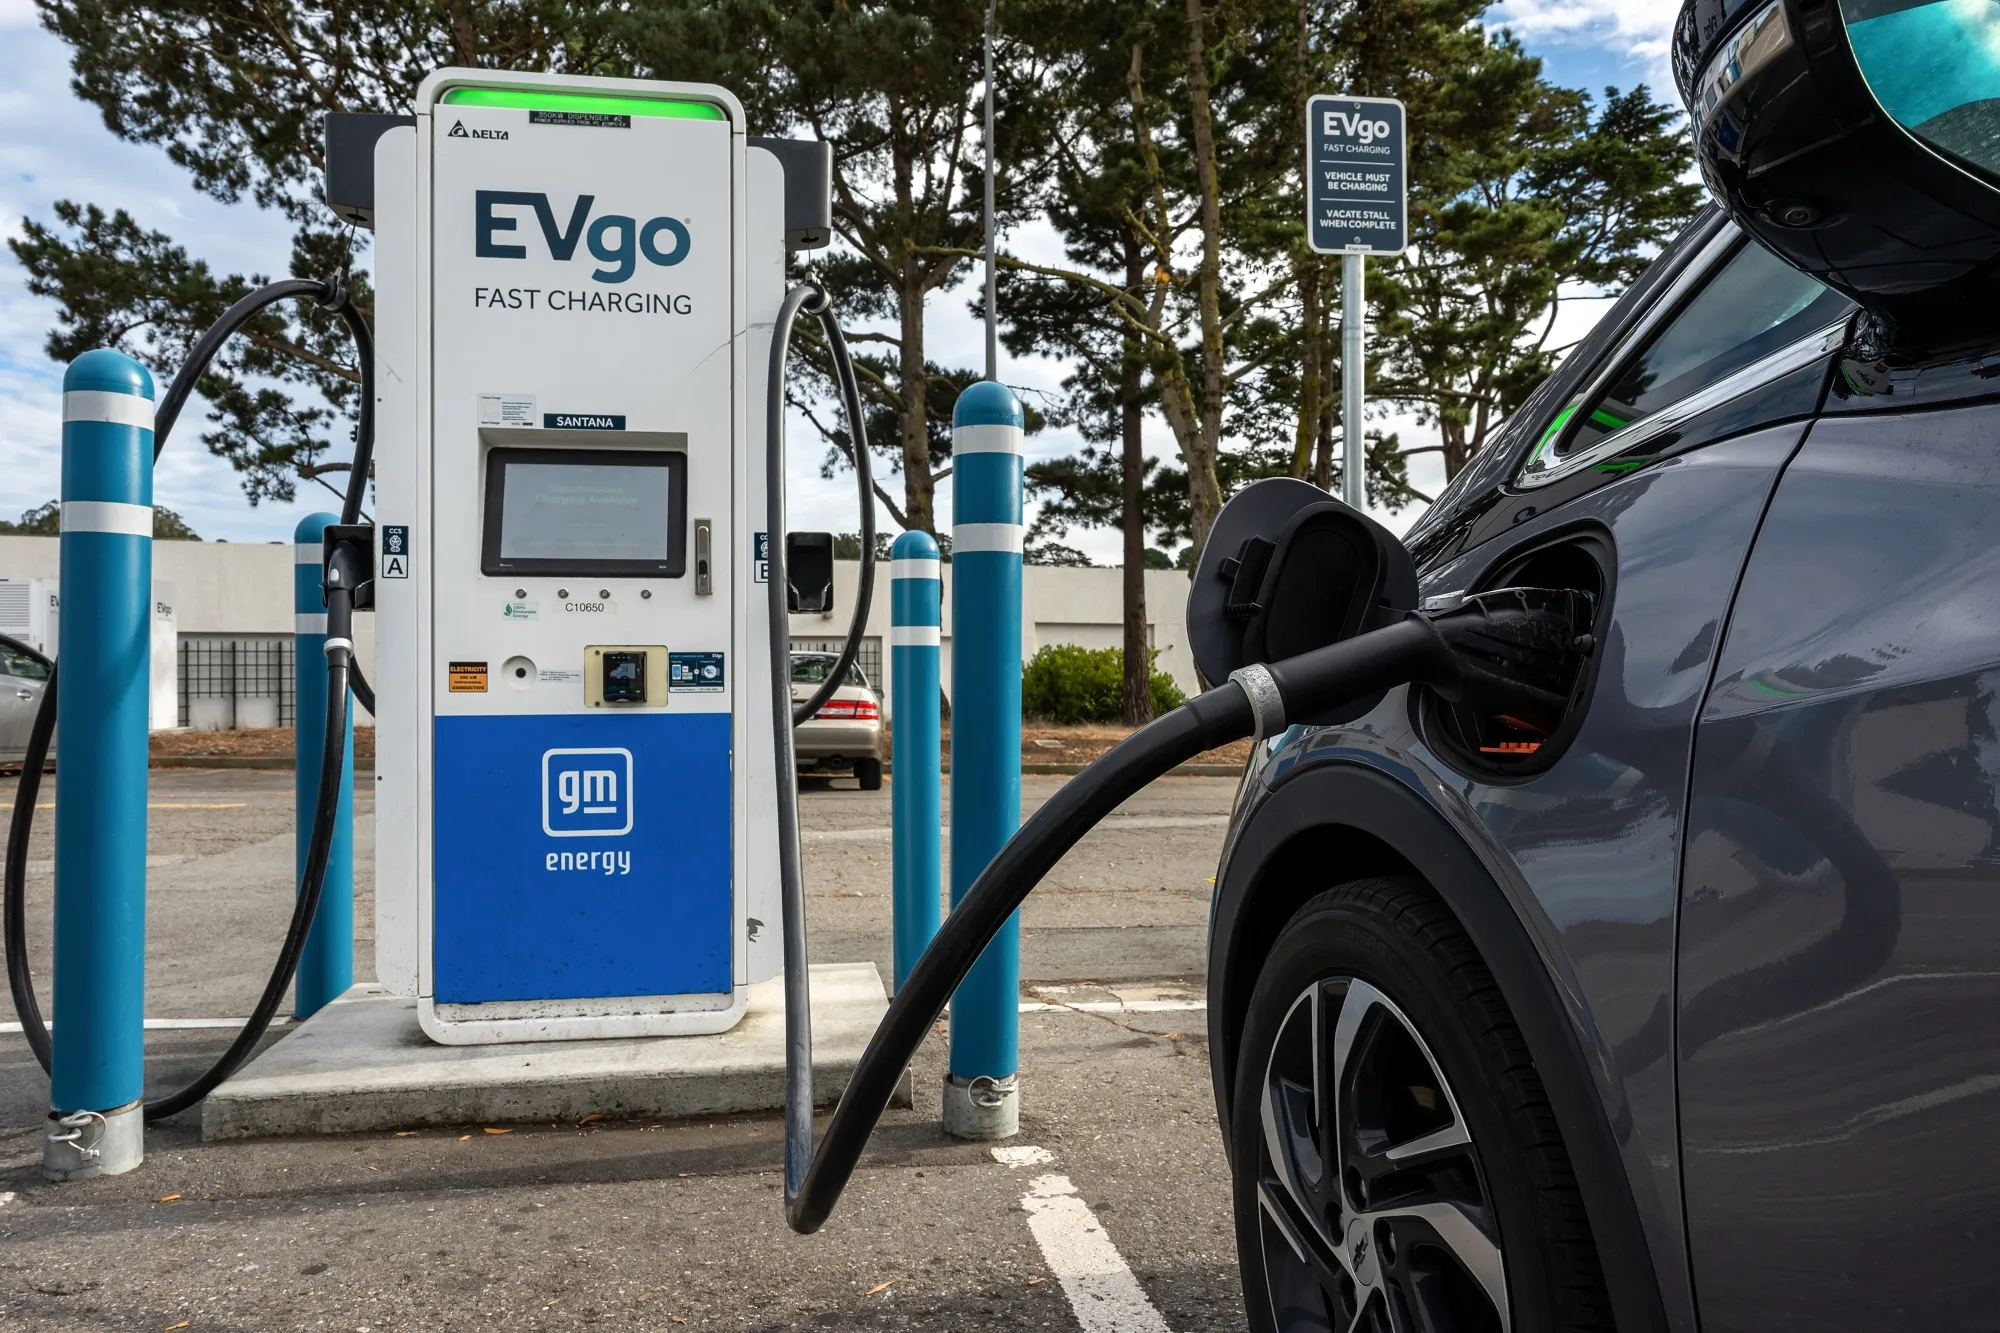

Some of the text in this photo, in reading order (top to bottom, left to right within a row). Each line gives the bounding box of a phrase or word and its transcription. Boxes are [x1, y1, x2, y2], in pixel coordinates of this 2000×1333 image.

[538, 111, 564, 119] 350KW
[567, 113, 609, 121] DISPENSER
[1323, 111, 1390, 144] EVgo
[472, 129, 509, 140] DELTA
[1323, 143, 1391, 155] FAST CHARGING
[1325, 171, 1390, 182] VEHICLE MUST
[1327, 182, 1388, 192] BE CHARGING
[1326, 209, 1390, 220] VACATE STALL
[1319, 219, 1397, 230] WHEN COMPLETE
[474, 190, 691, 284] EVgo
[474, 287, 692, 315] FAST CHARGING
[556, 416, 614, 428] SANTANA
[387, 557, 403, 575] A
[156, 602, 172, 617] EVgo
[565, 602, 605, 613] C10650
[558, 770, 617, 815] gm
[546, 850, 631, 875] energy
